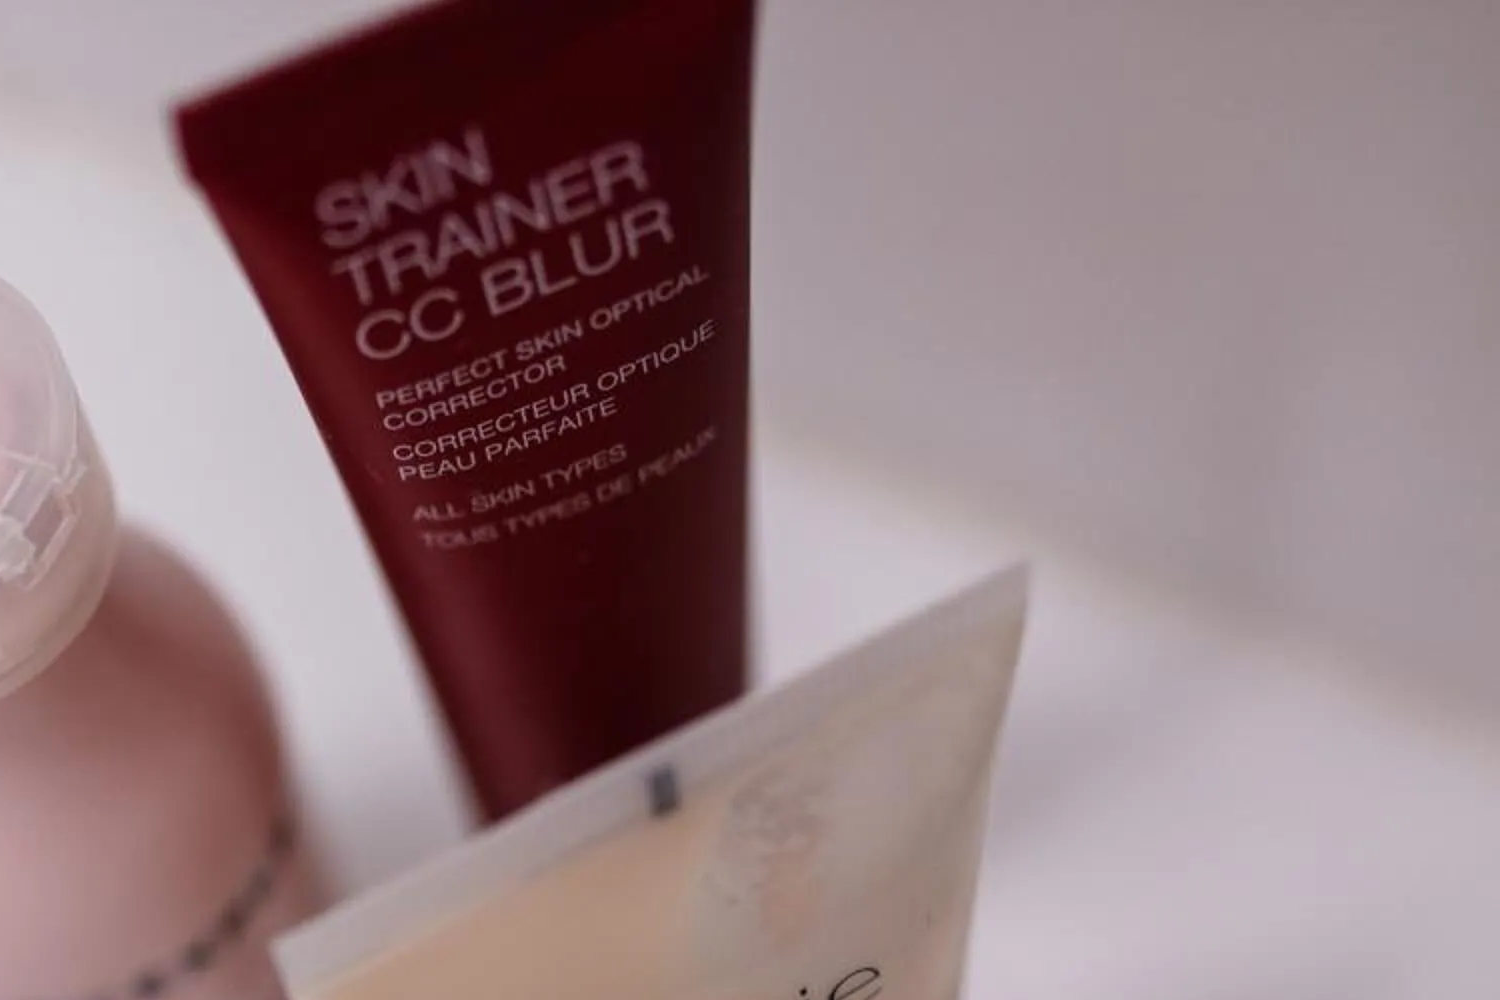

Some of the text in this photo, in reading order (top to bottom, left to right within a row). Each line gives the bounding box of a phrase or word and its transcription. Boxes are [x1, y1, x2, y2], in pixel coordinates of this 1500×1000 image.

[314, 125, 493, 248] SKIN
[332, 140, 650, 306] TRAINER
[356, 200, 675, 359] CC BLUR
[375, 265, 710, 410] PERFECT SKIN OPTICAL
[382, 356, 567, 430] CORRECTOR
[393, 320, 716, 461] CORRECTEUR OPTIQUE
[399, 397, 617, 481] PEAU PARFAITE
[413, 444, 627, 522] ALL SKIN TYPES
[504, 493, 592, 536] TYPES
[597, 476, 632, 503] DE
